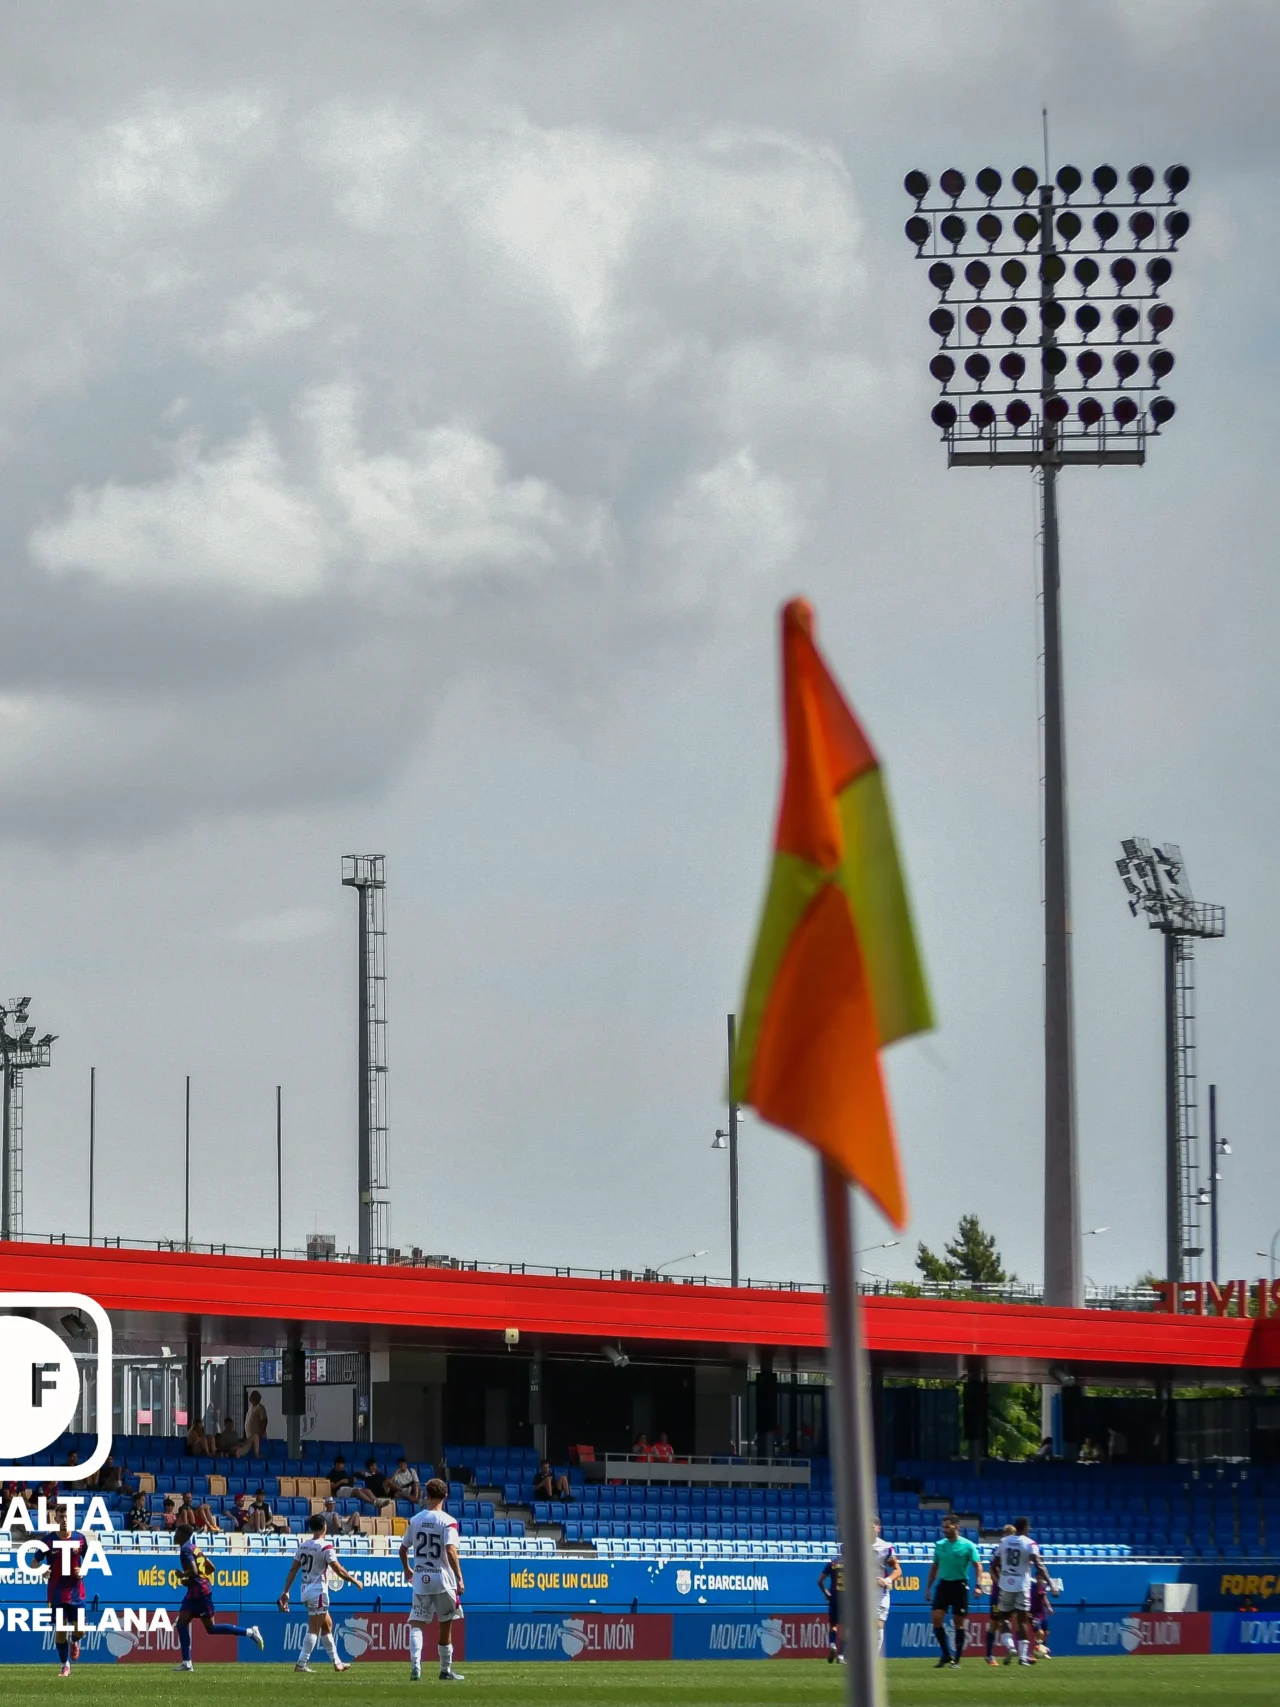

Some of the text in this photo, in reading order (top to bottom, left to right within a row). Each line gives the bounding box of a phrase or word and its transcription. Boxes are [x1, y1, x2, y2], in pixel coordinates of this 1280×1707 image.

[416, 1532, 441, 1558] 25
[1007, 1548, 1021, 1566] 18
[138, 1566, 166, 1586] MÉS
[218, 1570, 249, 1586] CLUB
[511, 1569, 608, 1590] MÉS QUE UN CLUB
[694, 1574, 768, 1590] FC BARCELONA
[895, 1576, 920, 1590] CLUB
[372, 1624, 388, 1650] EL
[506, 1619, 634, 1650] MOVEM EL MÓN
[710, 1619, 830, 1650] MOVEM EL MÓN
[1153, 1616, 1182, 1645] MÓN
